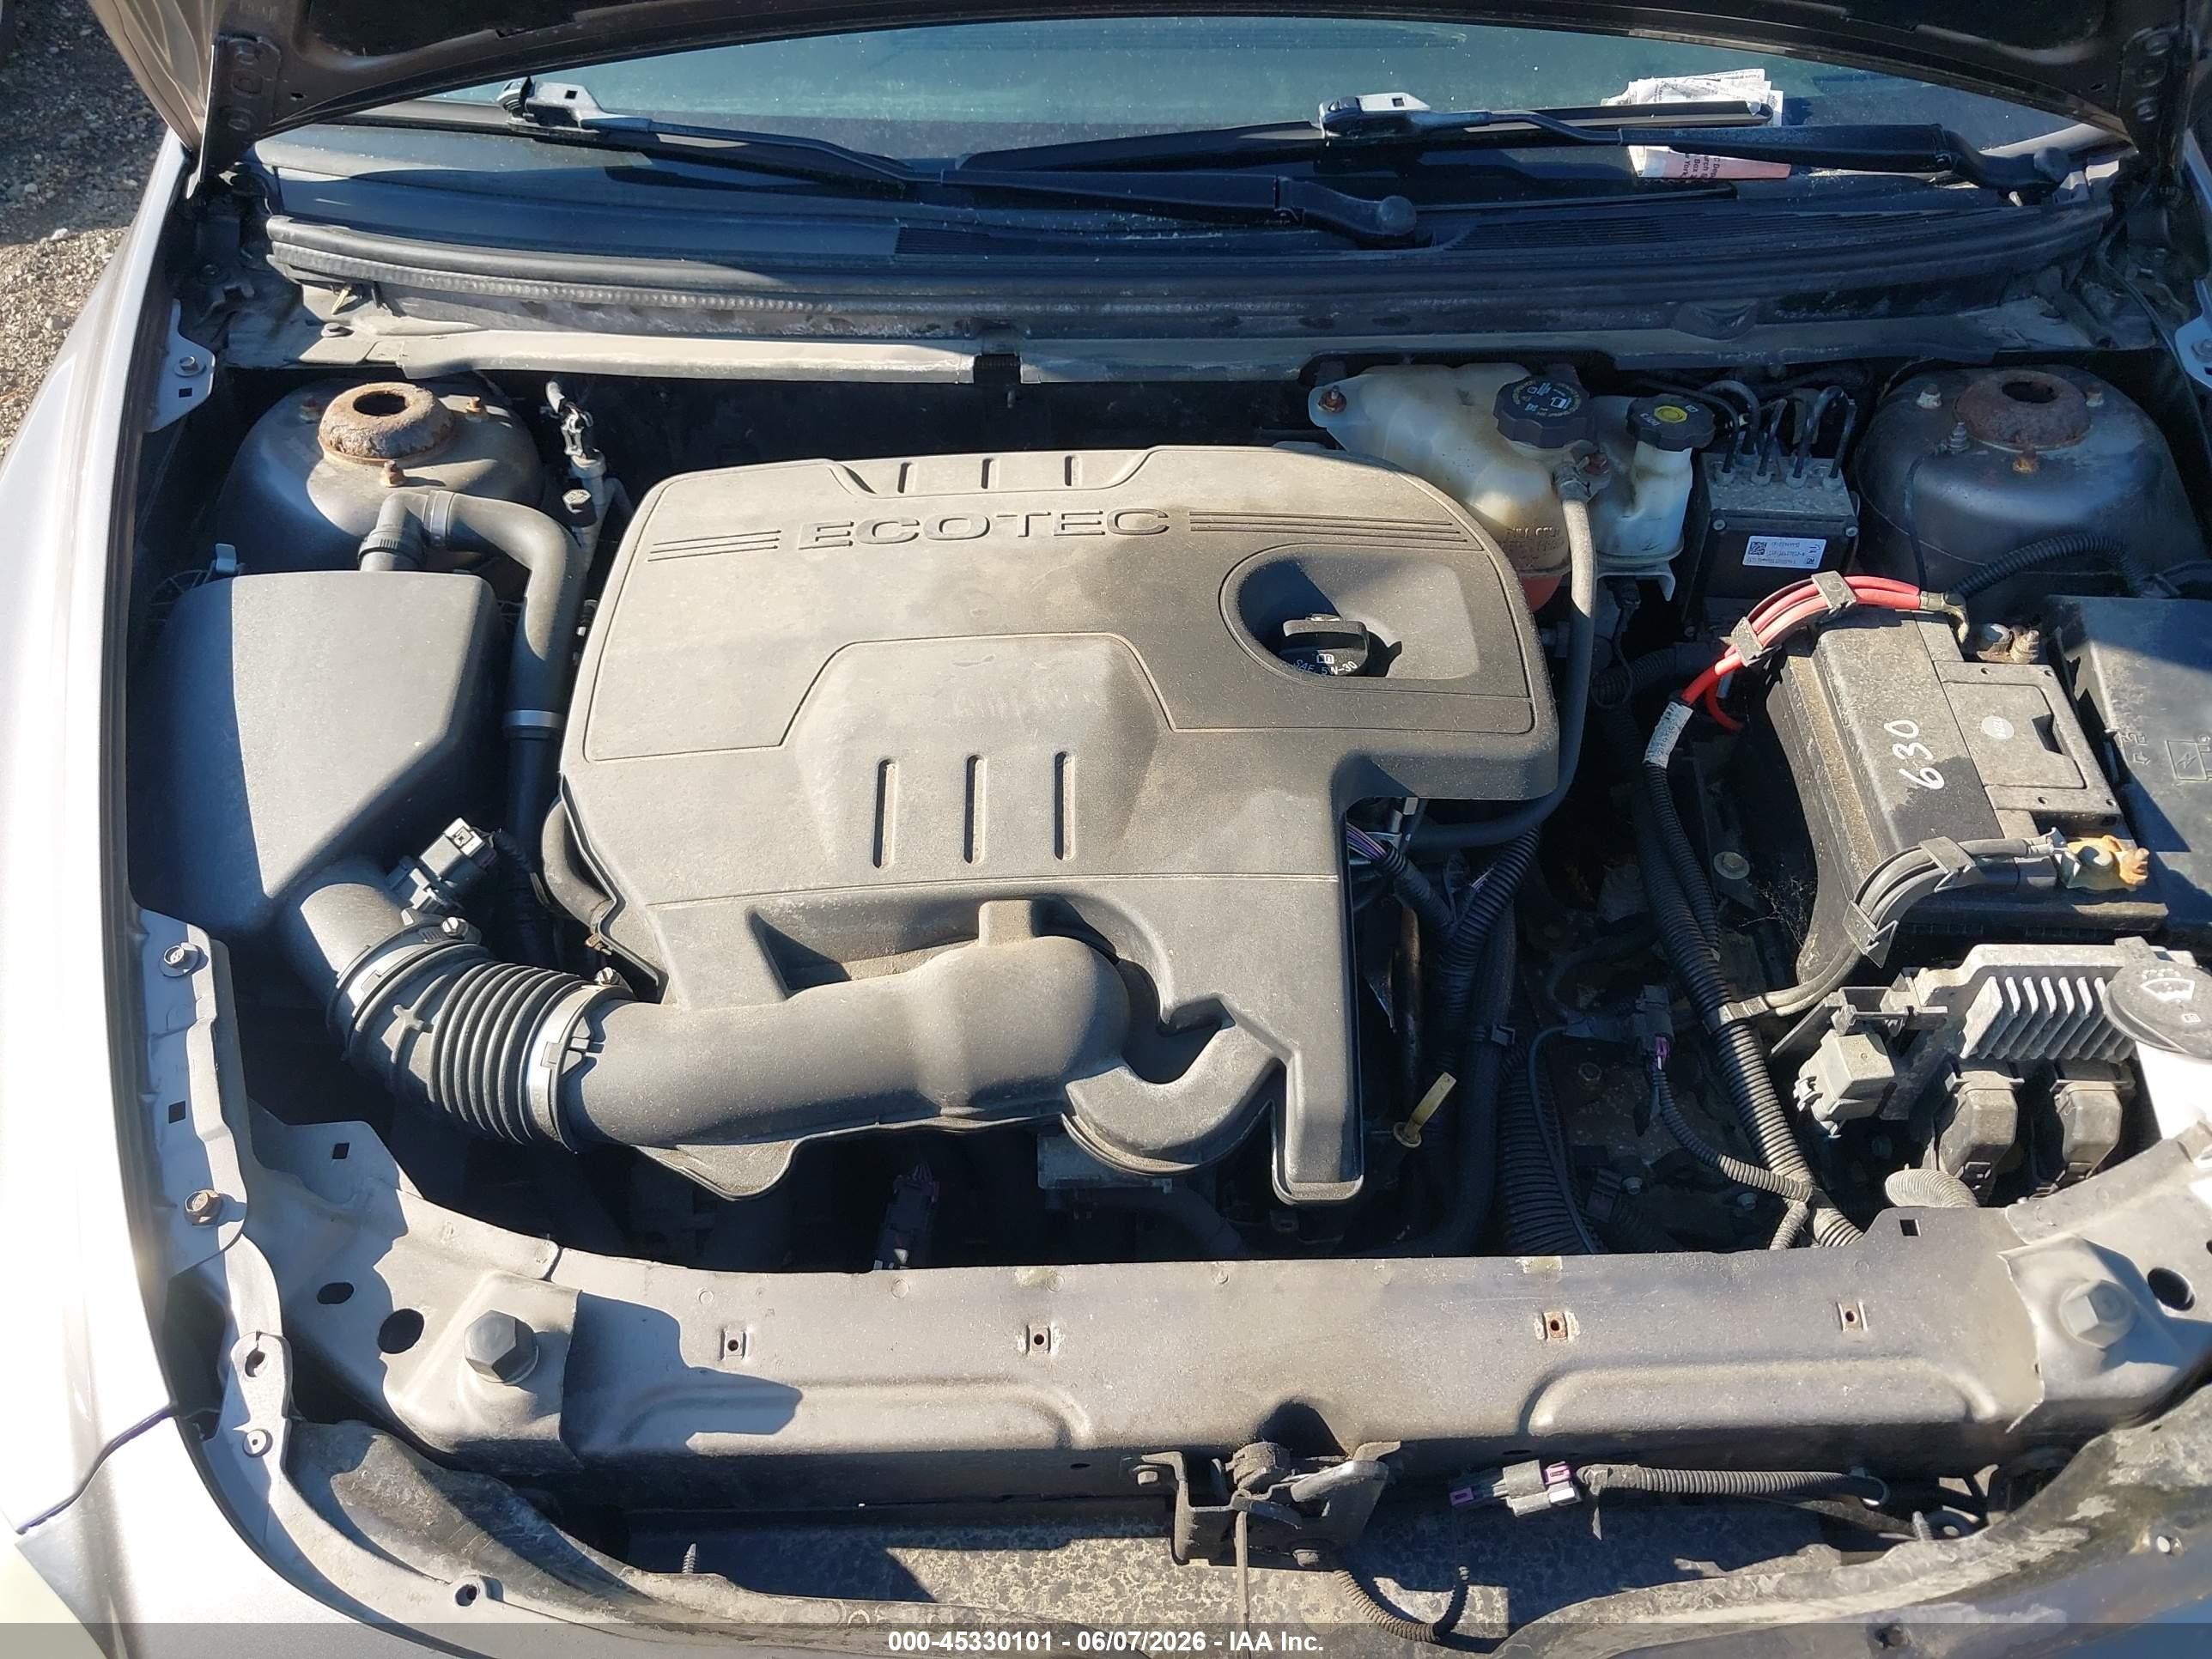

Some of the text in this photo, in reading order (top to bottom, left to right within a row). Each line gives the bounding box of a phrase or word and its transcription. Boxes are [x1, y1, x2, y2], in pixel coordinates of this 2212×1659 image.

[798, 507, 1170, 550] ECOTEC
[1296, 659, 1358, 676] SAE 5W-30
[1884, 720, 1945, 789] 630
